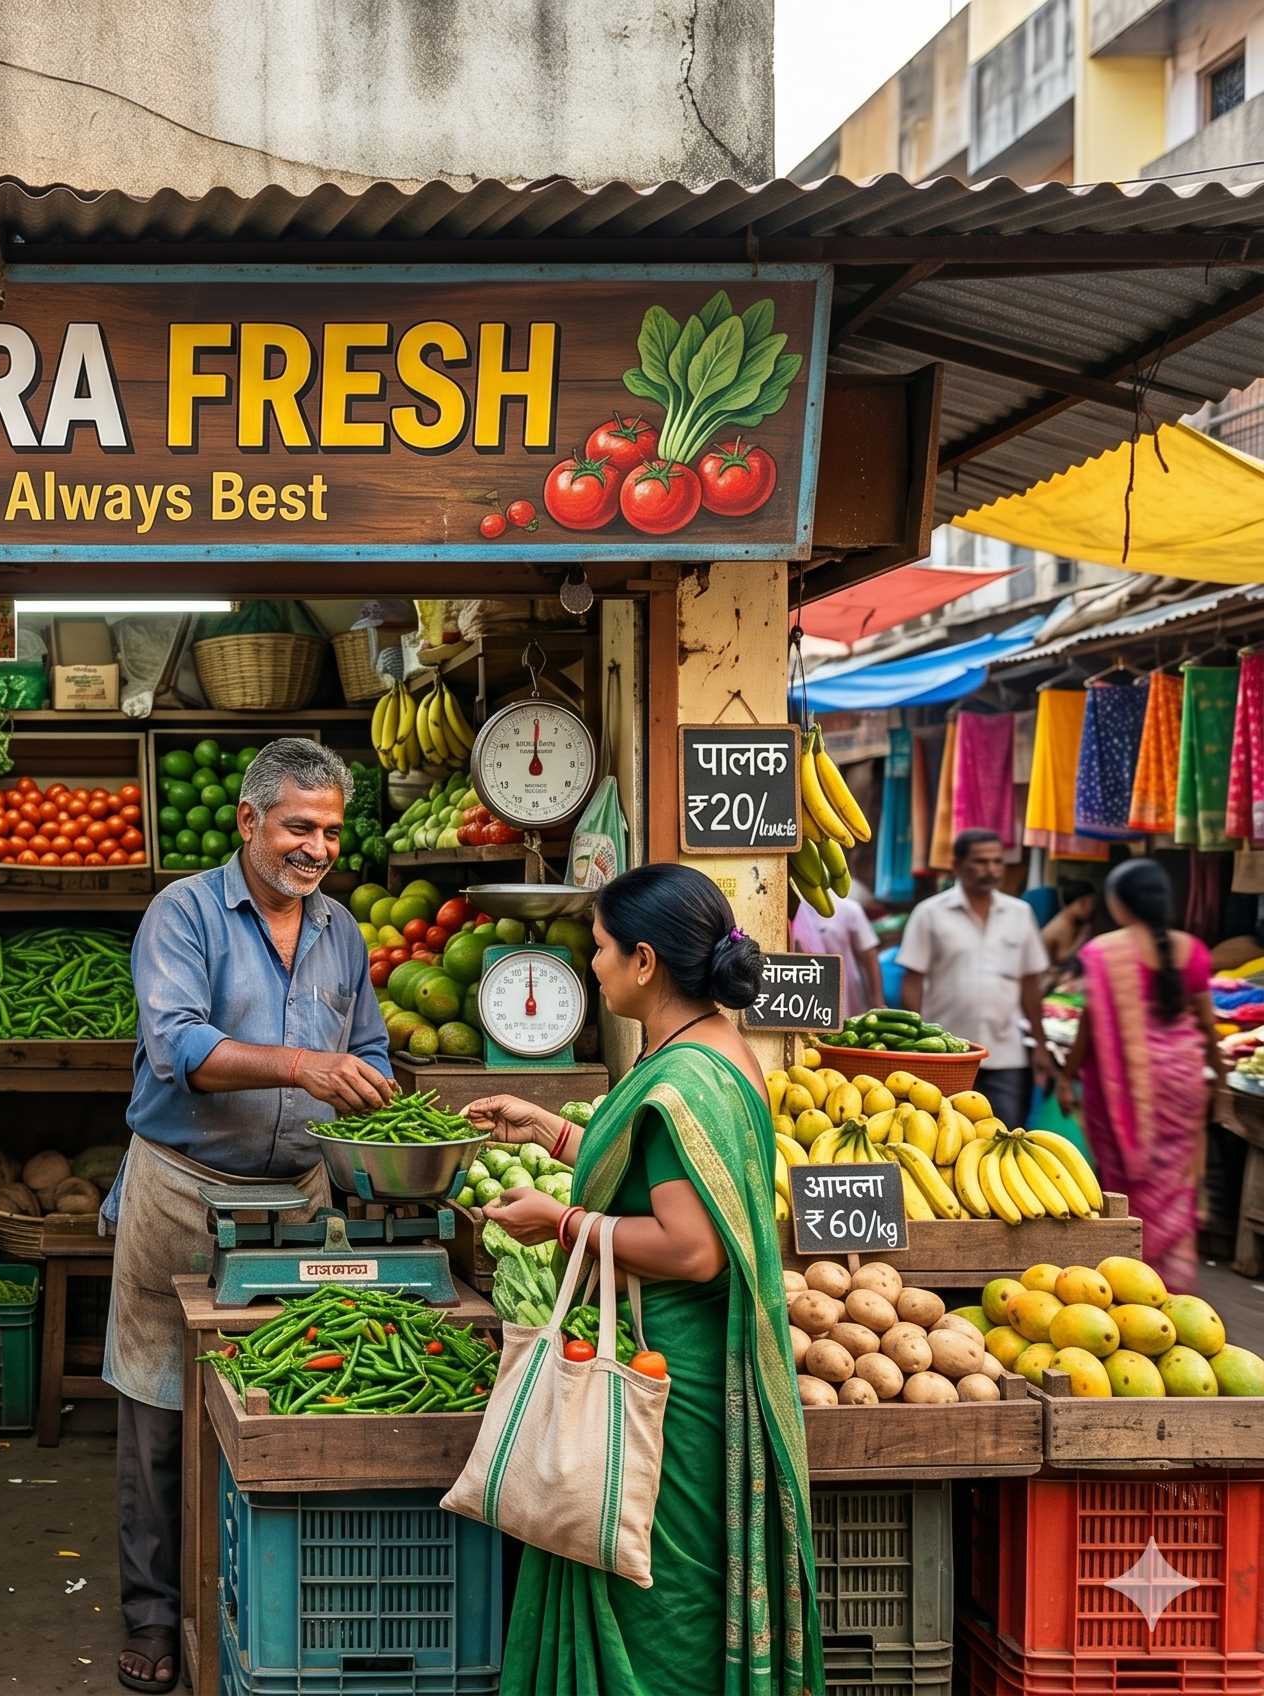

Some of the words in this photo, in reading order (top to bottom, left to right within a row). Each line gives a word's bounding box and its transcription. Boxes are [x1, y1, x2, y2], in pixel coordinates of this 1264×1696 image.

[166, 321, 561, 454] FRESH
[4, 471, 193, 534] Always
[211, 472, 329, 522] Best
[692, 743, 789, 776] पालक
[753, 993, 832, 1026] ₹40/kg
[804, 1209, 898, 1247] ₹60/kg
